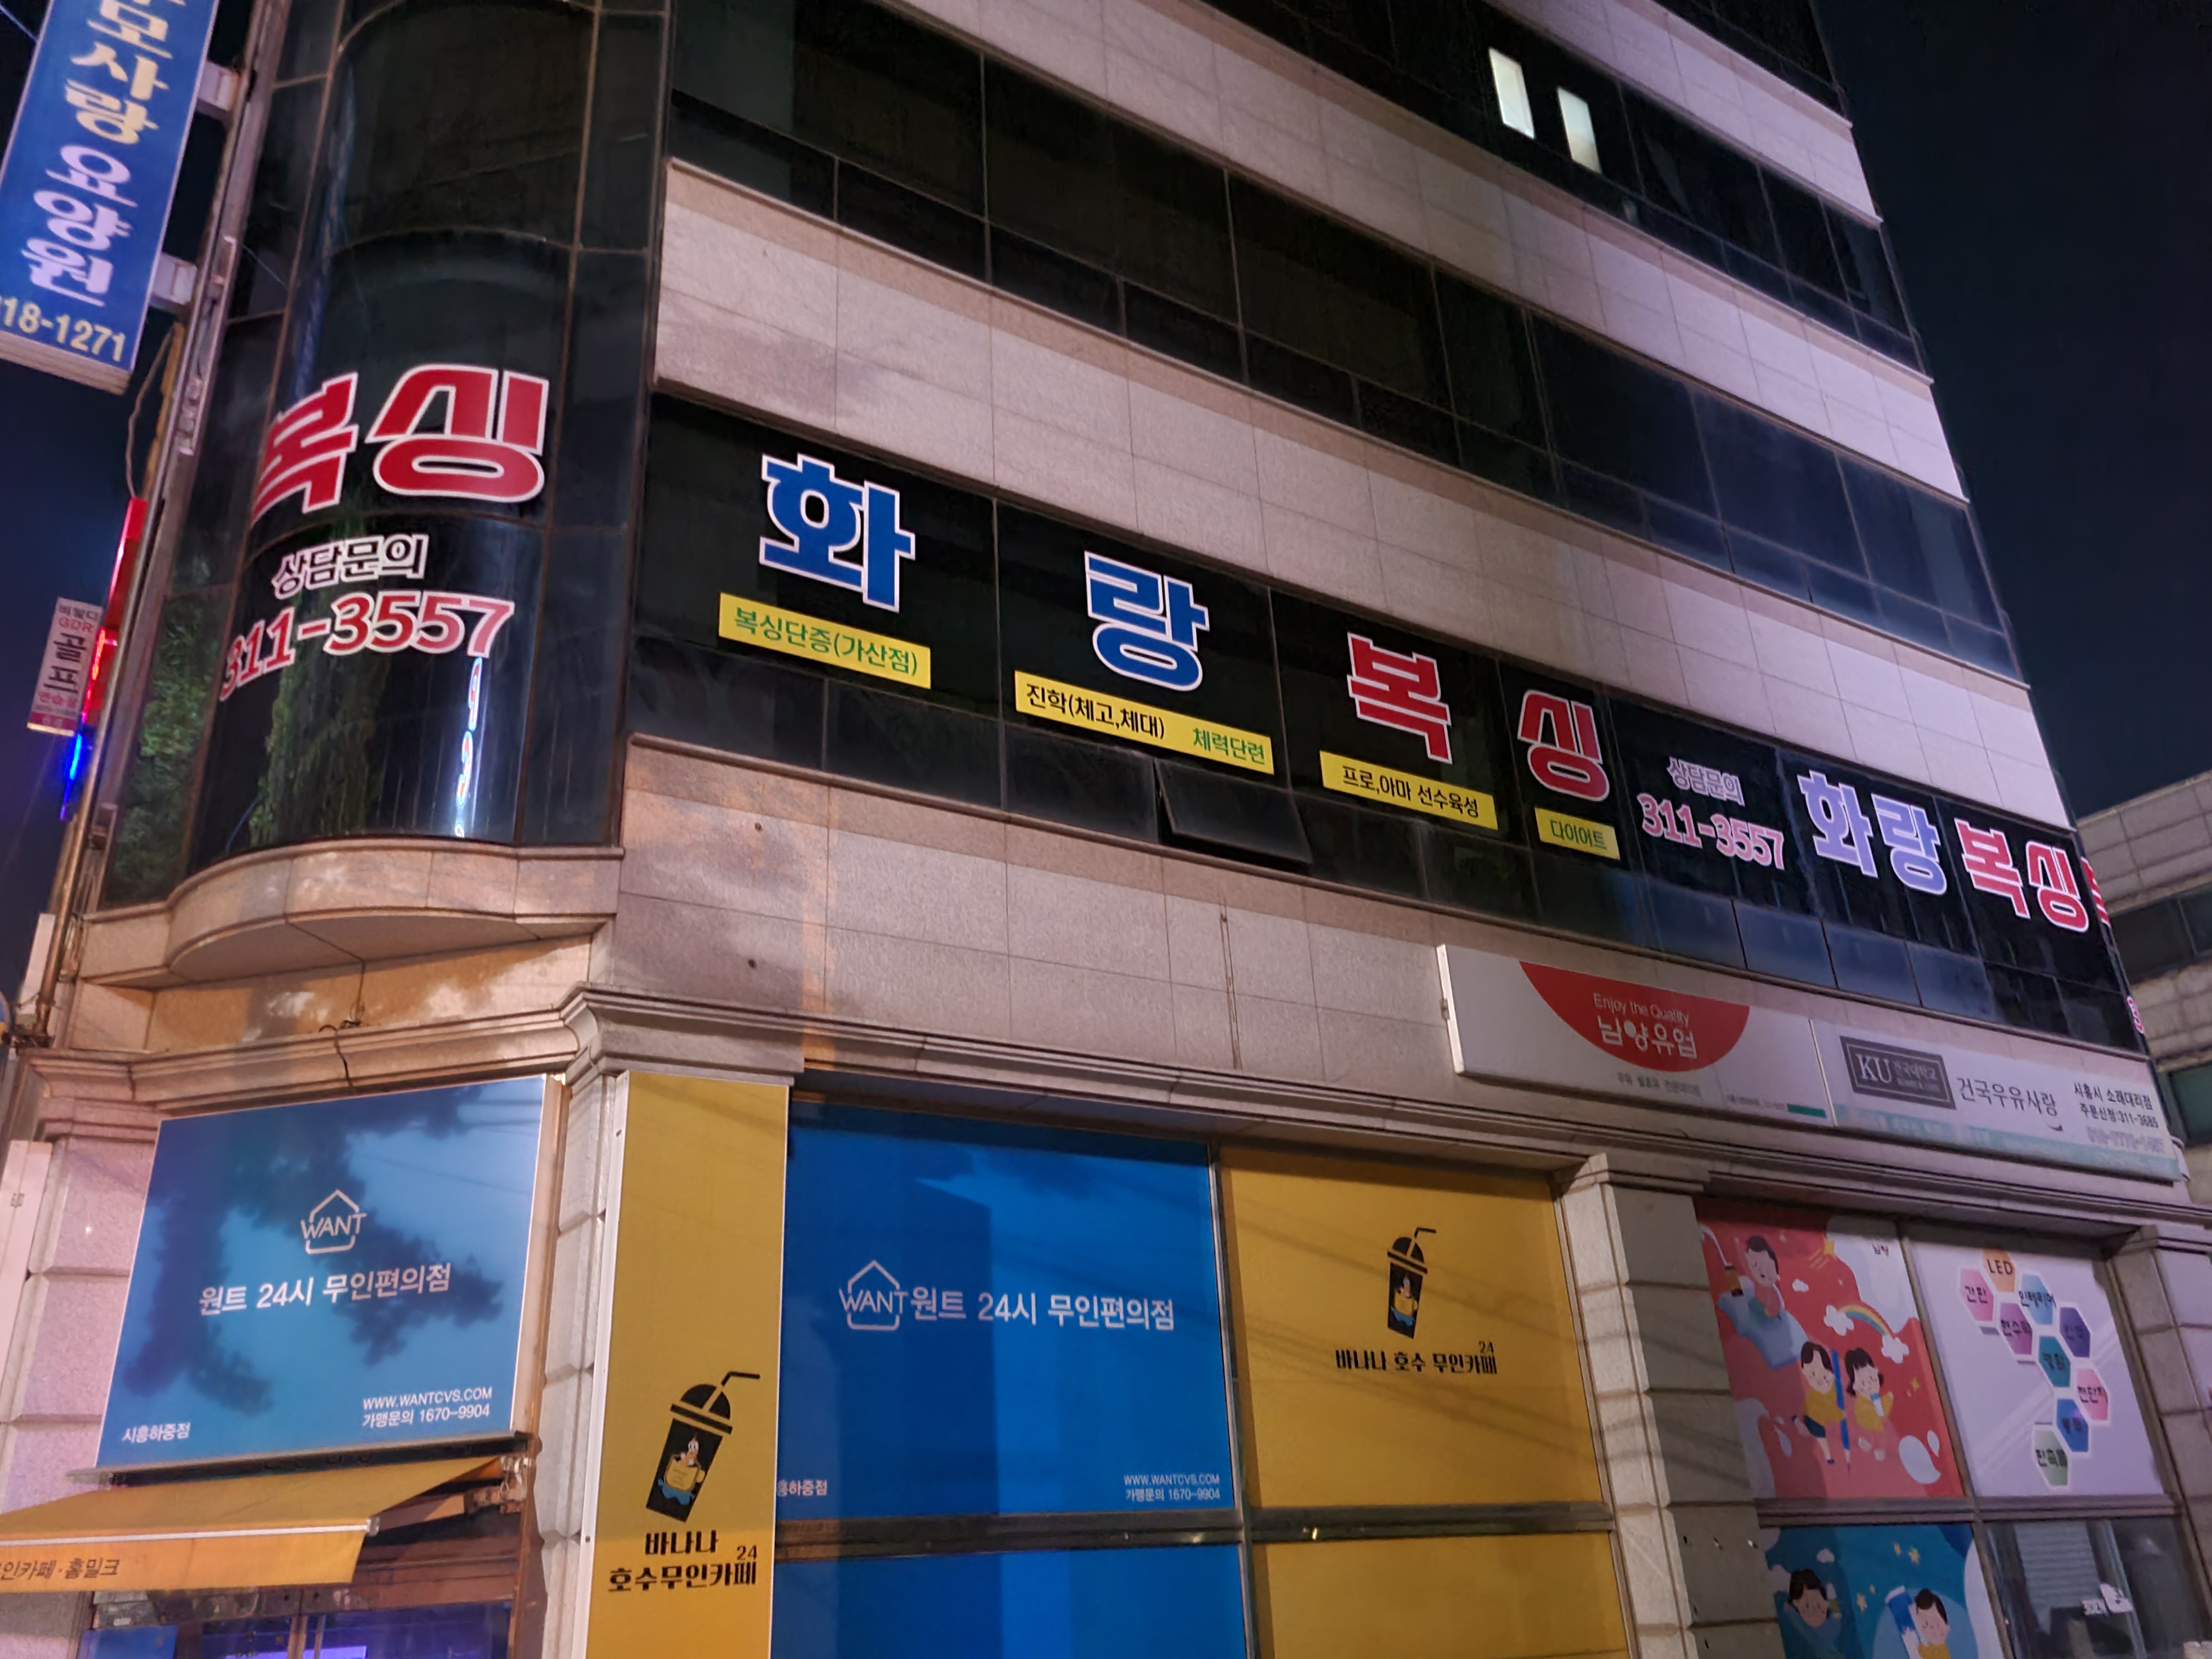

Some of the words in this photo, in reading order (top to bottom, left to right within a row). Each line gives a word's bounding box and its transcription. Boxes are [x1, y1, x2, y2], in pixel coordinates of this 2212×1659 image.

[65, 0, 185, 144] 모사랑
[21, 145, 138, 307] 요양원
[0, 297, 126, 363] 18-1271
[272, 534, 430, 599] 상담문의
[219, 590, 515, 702] 311-3557
[735, 607, 917, 676] 복싱단증(가산점)
[43, 633, 86, 694] 골프
[1026, 683, 1165, 740] 진학(체고,체대)
[1193, 727, 1265, 765] 체력단련
[1342, 765, 1411, 801] 프로,아마
[1418, 784, 1479, 819] 선수육성
[1666, 756, 1746, 806] 상담문의
[1549, 820, 1607, 850] 다이어트
[1637, 792, 1785, 871] 311-3557
[1797, 770, 1947, 895] 화랑
[1954, 818, 2089, 933] 복싱
[1593, 992, 1627, 1015] Enjoy
[1629, 1001, 1649, 1016] the
[1650, 1004, 1689, 1029] Quality
[1597, 1015, 1698, 1059] 남양유업
[1855, 1053, 1892, 1084] KU
[1957, 1077, 2057, 1116] 건국우유사랑
[2074, 1082, 2103, 1102] 시흥시
[301, 1211, 367, 1240] WANT
[1987, 1259, 2013, 1276] LED
[199, 1284, 247, 1316] 원트
[256, 1276, 313, 1309] 24시
[322, 1262, 452, 1304] 무인편의점
[839, 1287, 909, 1314] WANT
[1965, 1285, 1988, 1304] 간판
[2019, 1290, 2056, 1308] 인테리어
[911, 1286, 966, 1320] 원트
[978, 1291, 1036, 1325] 24시
[1048, 1294, 1174, 1331] 무인편의점
[1393, 1351, 1425, 1372] 호수
[1432, 1352, 1497, 1374] 무인카페
[1478, 1341, 1494, 1354] 24
[363, 1387, 492, 1410] WWW.WANTCVS.COM
[362, 1409, 414, 1428] 가맹문의
[420, 1403, 490, 1423] 1670-9904
[122, 1423, 190, 1444] 시흥하중점
[1124, 1474, 1220, 1486] WWW.WANTCVS.COM
[1126, 1488, 1164, 1502] 가맹문의
[1169, 1488, 1220, 1501] 1670-9904
[645, 1530, 719, 1555] 바나나
[736, 1545, 757, 1560] 24
[0, 1560, 57, 1580] 인카페
[608, 1561, 757, 1592] 호수무인카페
